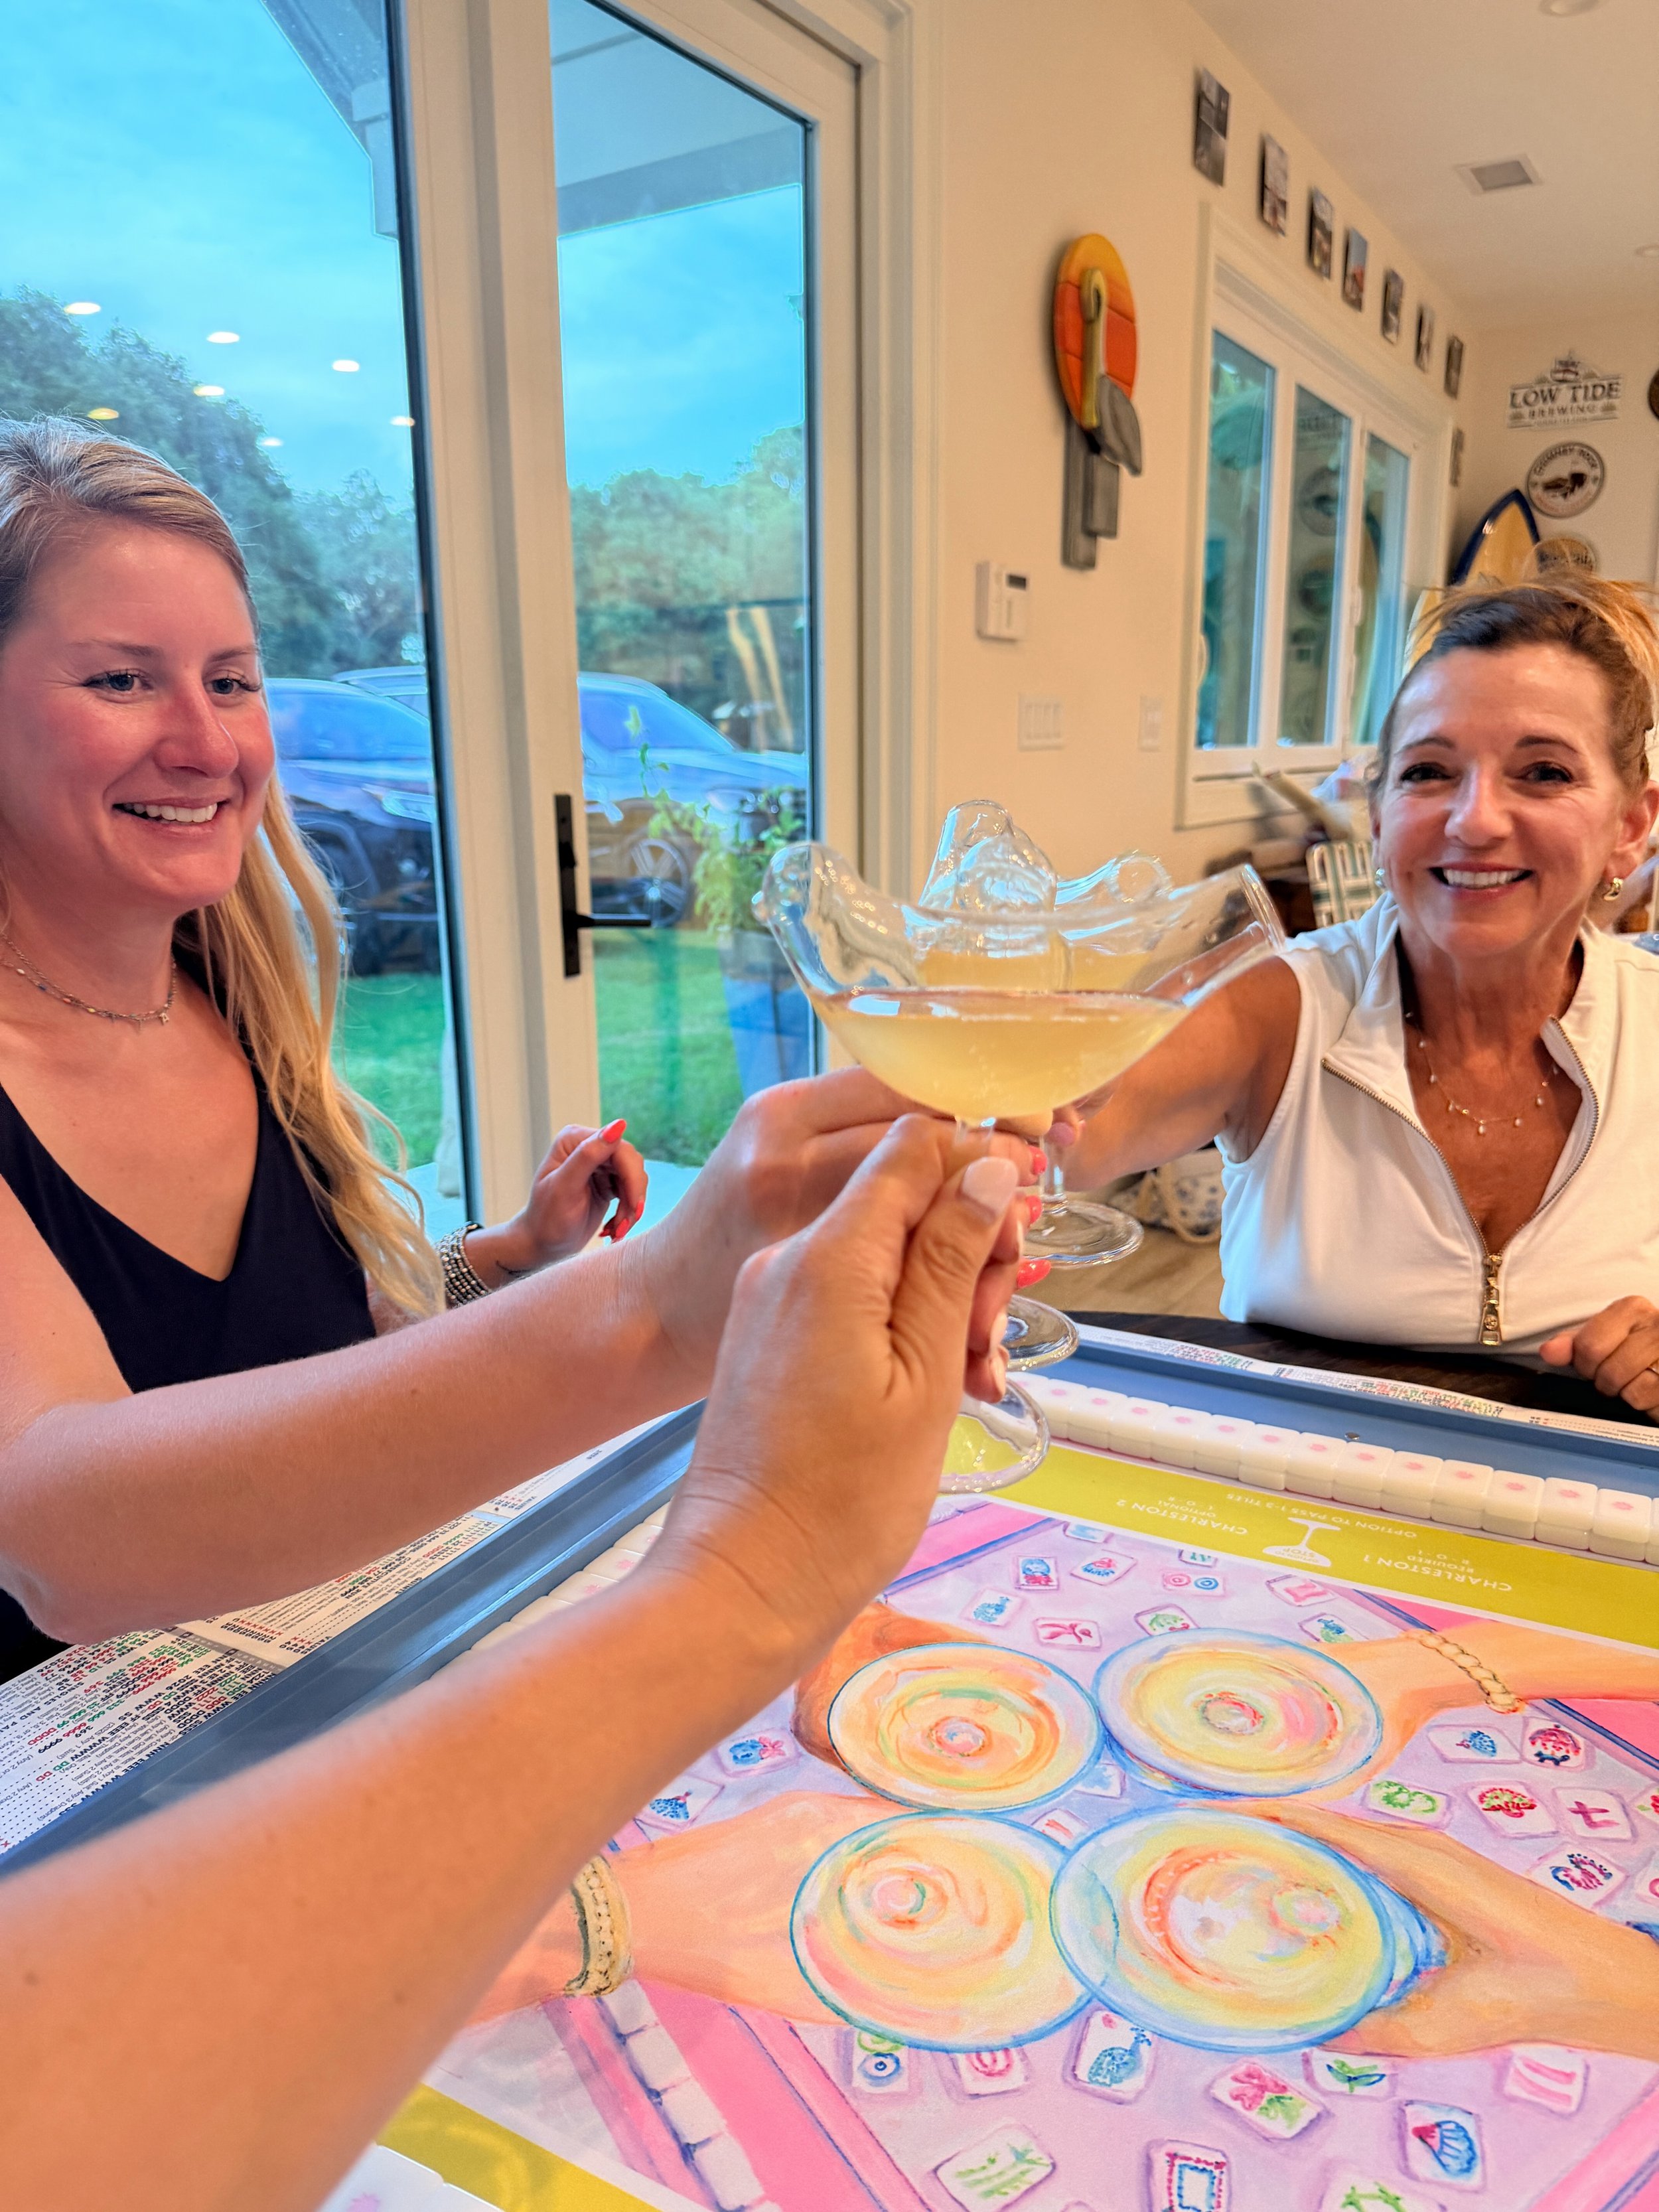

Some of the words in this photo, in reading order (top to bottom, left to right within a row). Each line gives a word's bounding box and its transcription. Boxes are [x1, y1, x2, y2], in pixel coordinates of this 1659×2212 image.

[1510, 387, 1558, 409] LOW
[1568, 381, 1621, 404] TIDE
[1116, 1499, 1127, 1507] 2
[1131, 1502, 1248, 1535] CHARLESTON
[1291, 1507, 1327, 1520] PASS
[1331, 1516, 1350, 1526] TO
[1354, 1520, 1417, 1538] OPTION
[1377, 1557, 1512, 1591] CHARLESTON
[36, 1658, 64, 1672] 2026
[44, 1672, 58, 1681] 77
[166, 1675, 192, 1690] 2026
[246, 1671, 269, 1684] 1234
[84, 1680, 104, 1693] 369
[102, 1677, 130, 1693] NEWS
[116, 1684, 140, 1698] 9999
[226, 1683, 248, 1696] DDD
[44, 1682, 84, 1705] SINGLES
[162, 1691, 178, 1700] DD
[173, 1684, 200, 1702] WWW
[135, 1692, 165, 1711] WWW
[147, 1700, 163, 1710] DD
[164, 1696, 192, 1714] DDDD
[205, 1696, 227, 1710] DDD
[20, 1706, 40, 1720] AND
[167, 1702, 195, 1720] WWW
[204, 1701, 232, 1719] WWW
[177, 1710, 205, 1728] DDDD
[28, 1728, 57, 1745] DDDD
[62, 1722, 86, 1737] 6666
[75, 1726, 94, 1737] 369
[38, 1738, 62, 1753] 9999
[70, 1737, 109, 1761] WWWW
[52, 1761, 69, 1771] DD
[36, 1771, 52, 1781] DD
